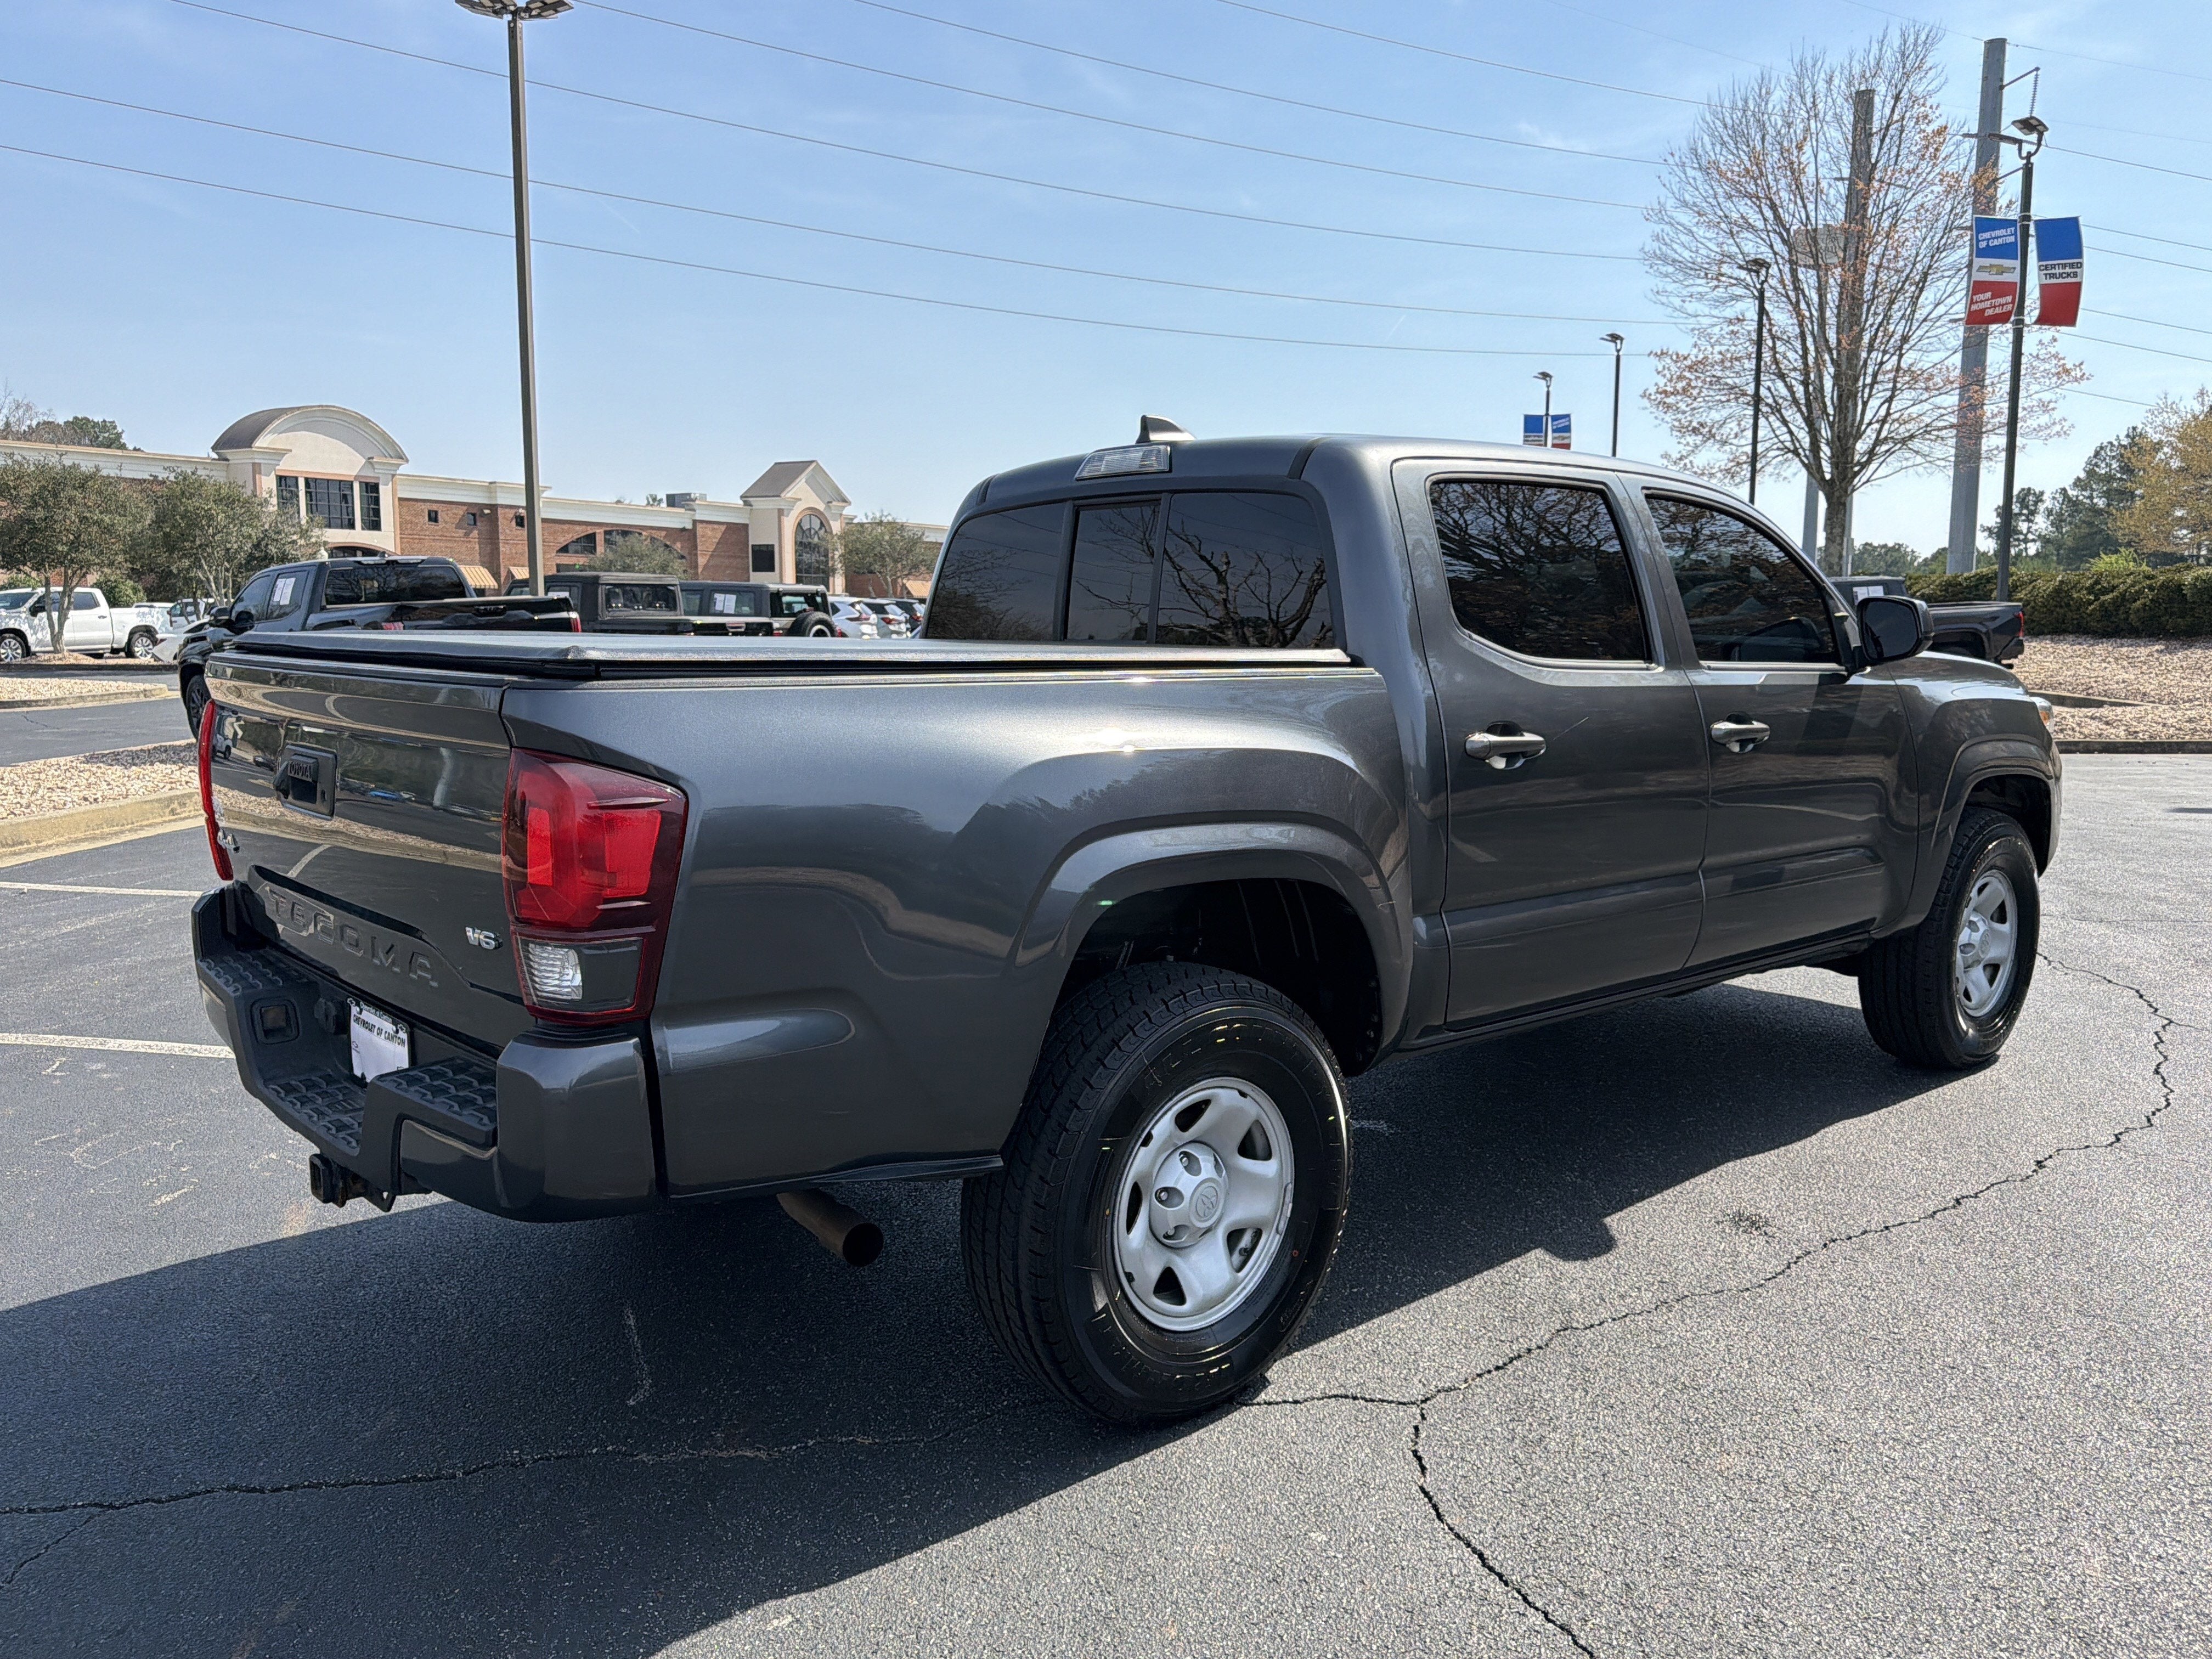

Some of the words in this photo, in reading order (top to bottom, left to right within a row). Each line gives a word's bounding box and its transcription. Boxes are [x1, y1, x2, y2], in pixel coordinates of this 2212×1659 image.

[1978, 227, 2015, 240] CHEVROLET
[1979, 240, 1988, 249] OF
[1989, 235, 2015, 247] CANTON
[2038, 262, 2083, 272] CERTIFIED
[2043, 271, 2078, 280] TRUCKS
[1971, 295, 2012, 312] HOMETOWN
[1973, 291, 1991, 302] YOUR
[1984, 303, 2013, 317] DEALER
[465, 927, 495, 950] V6
[353, 1014, 376, 1034] CHEVROLET
[377, 1026, 383, 1037] OF
[384, 1030, 406, 1048] CANTON
